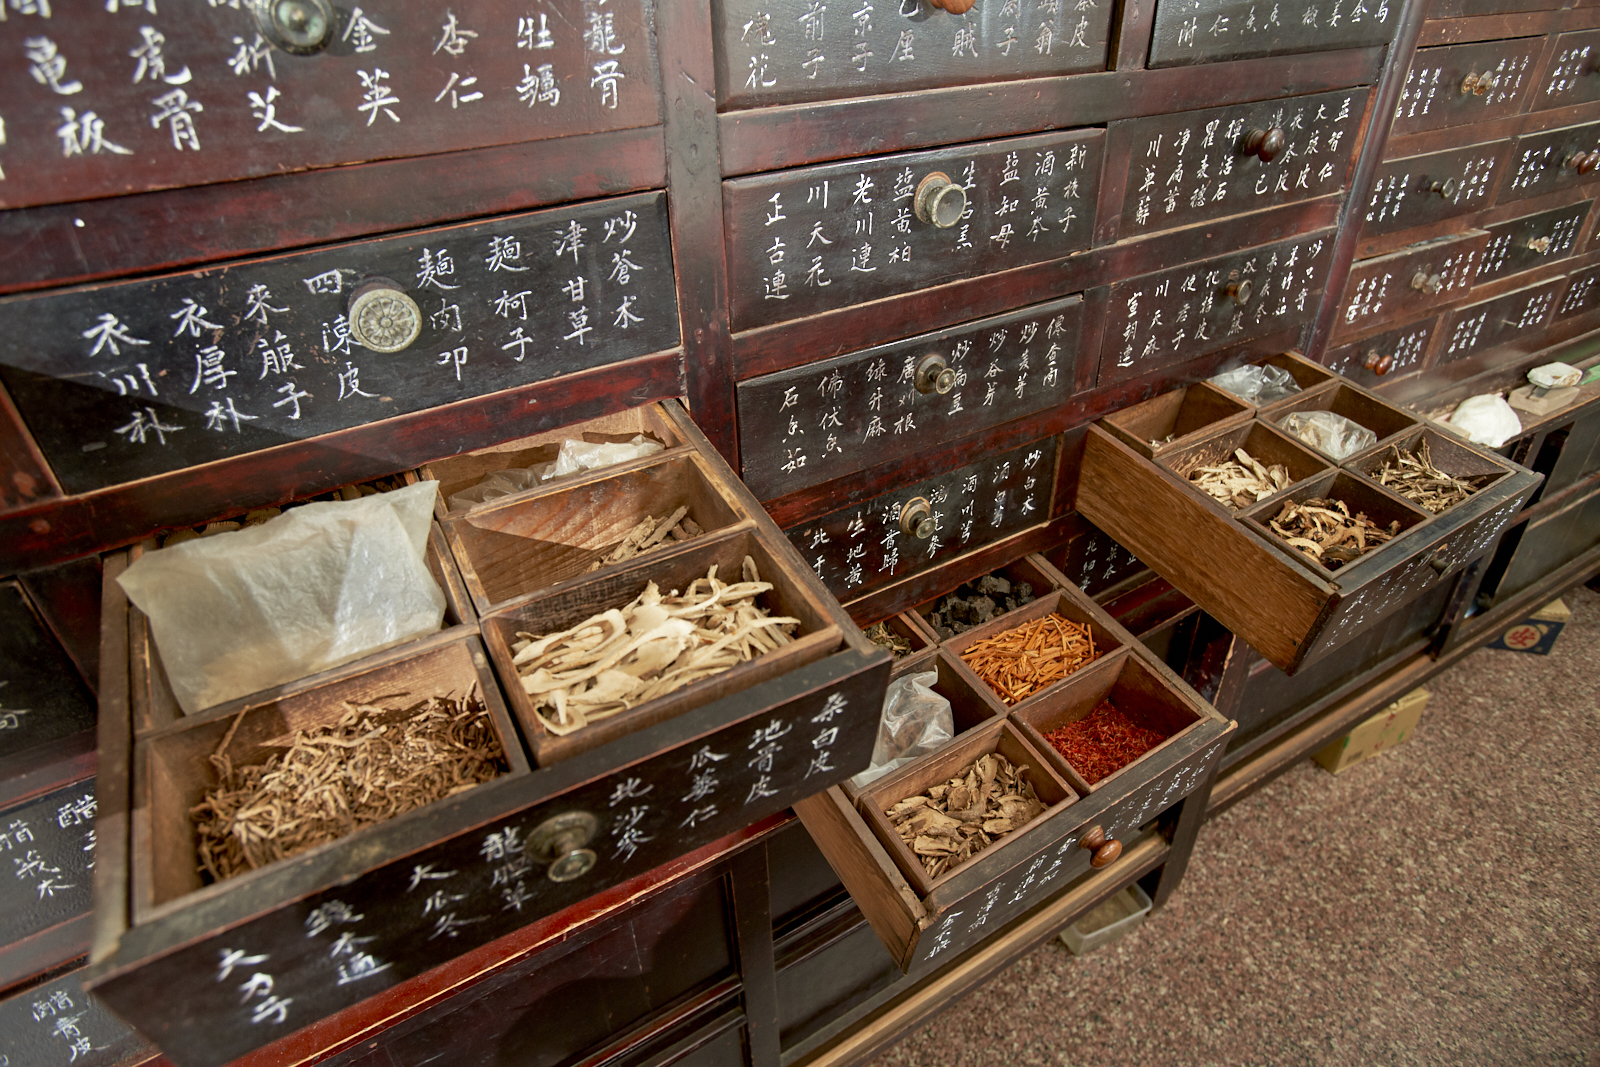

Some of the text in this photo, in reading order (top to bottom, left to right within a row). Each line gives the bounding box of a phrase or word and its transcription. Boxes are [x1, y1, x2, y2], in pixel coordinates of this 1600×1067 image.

[432, 9, 484, 109] 杏仁
[952, 3, 981, 58] 賊
[850, 173, 877, 273] 老川連
[743, 717, 794, 806] 地骨皮
